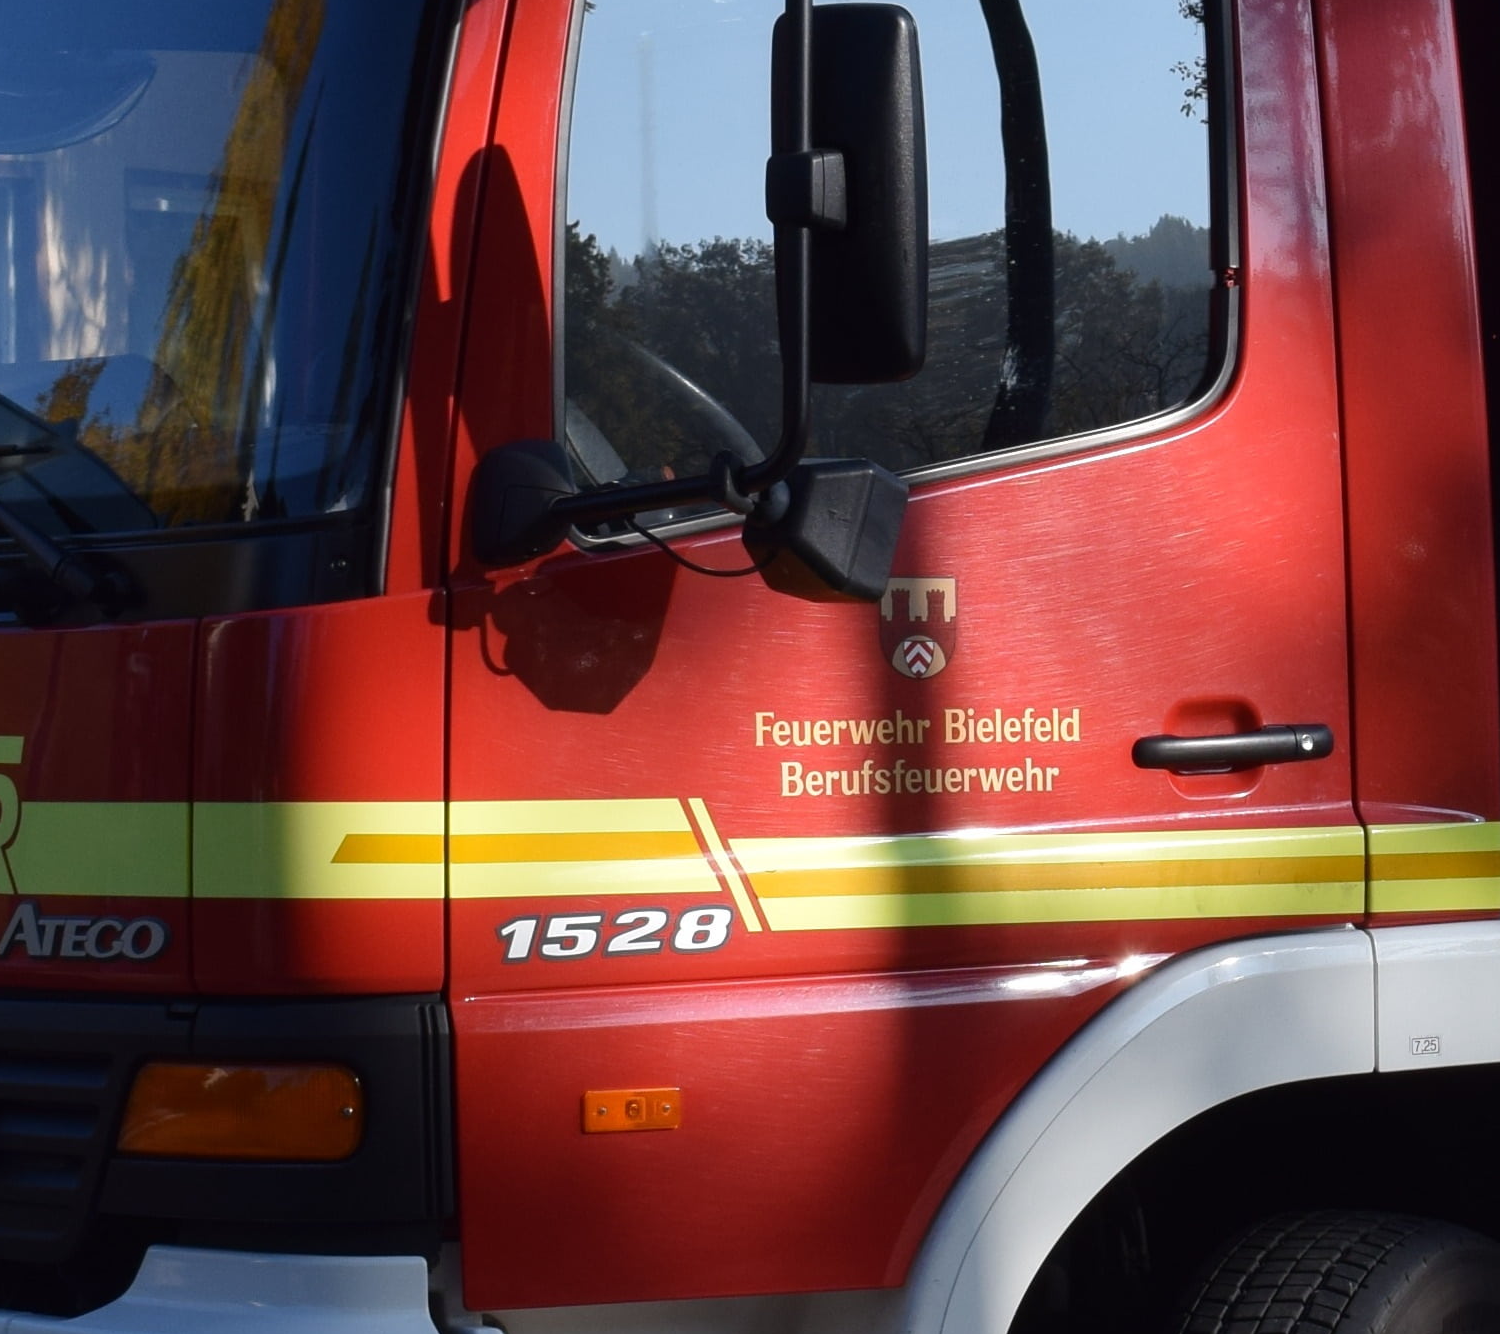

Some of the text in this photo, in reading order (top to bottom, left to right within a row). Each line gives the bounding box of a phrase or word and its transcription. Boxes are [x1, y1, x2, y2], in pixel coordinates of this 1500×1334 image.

[754, 707, 1081, 747] Feuerwehr Bielefeld
[780, 758, 1060, 798] Berufsfeuerwehr
[499, 905, 736, 961] 1528
